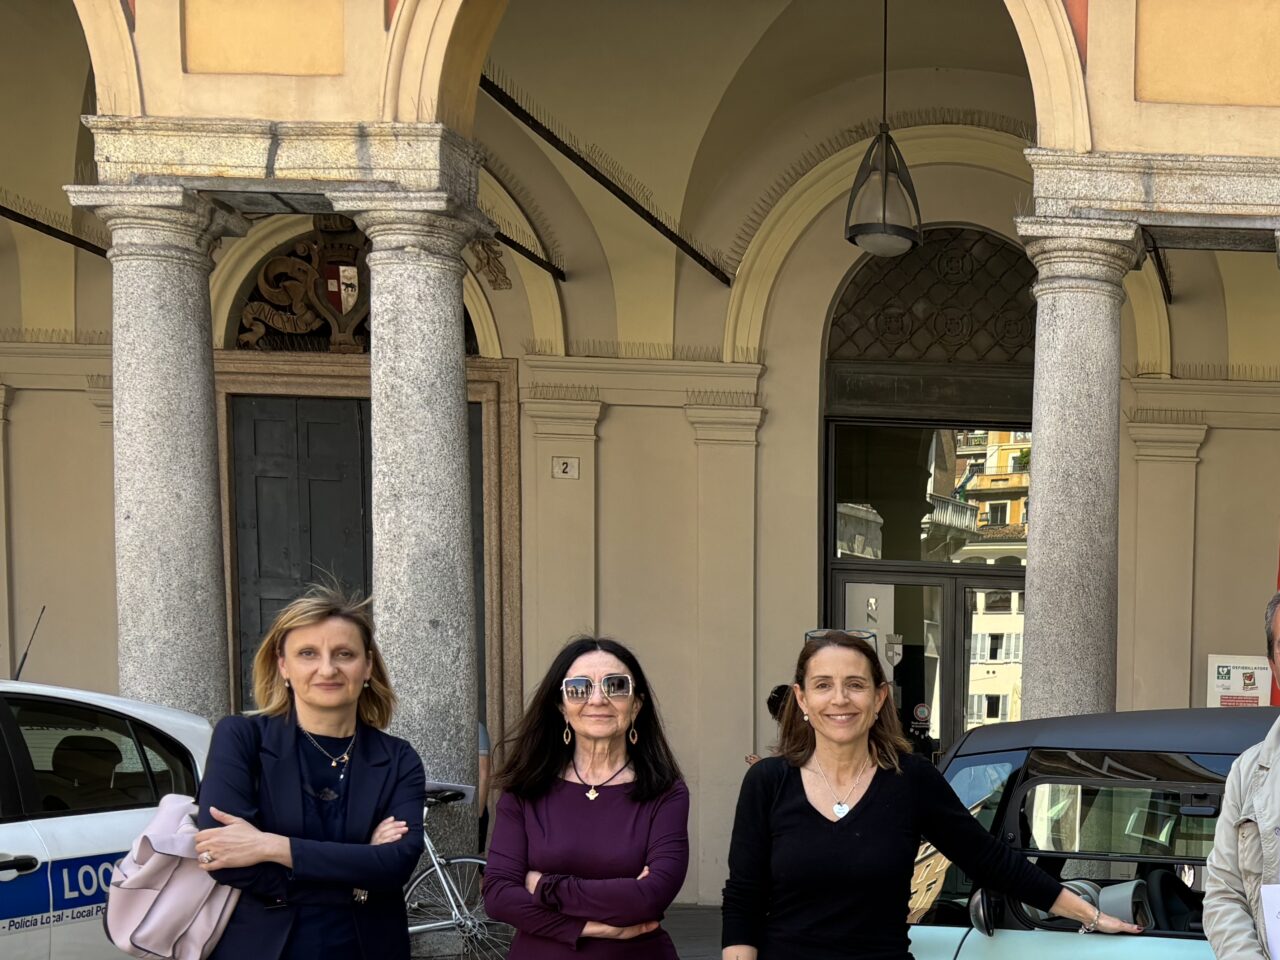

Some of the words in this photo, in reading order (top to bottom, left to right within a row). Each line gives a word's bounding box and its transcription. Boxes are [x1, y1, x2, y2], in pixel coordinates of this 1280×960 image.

[562, 462, 569, 474] 2
[62, 861, 113, 899] LOC
[40, 911, 64, 926] Local
[71, 908, 94, 920] Local
[95, 905, 106, 914] Po
